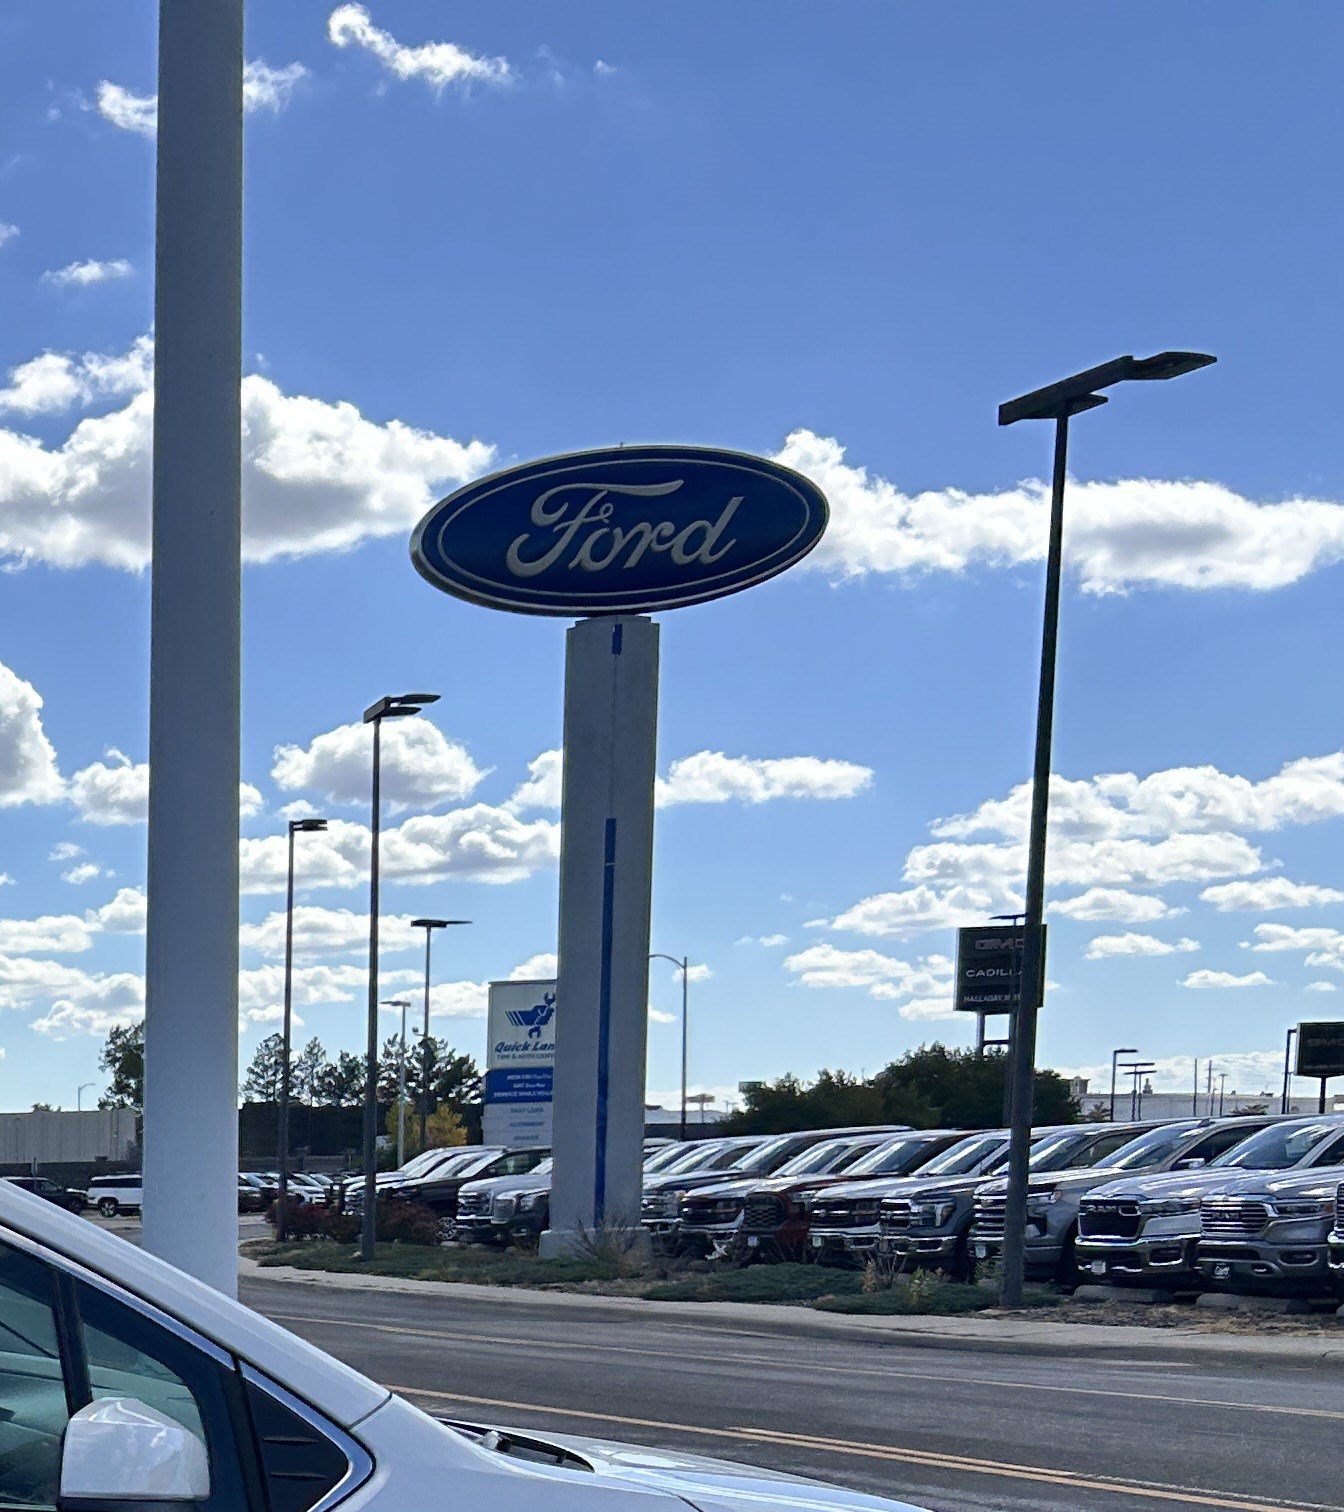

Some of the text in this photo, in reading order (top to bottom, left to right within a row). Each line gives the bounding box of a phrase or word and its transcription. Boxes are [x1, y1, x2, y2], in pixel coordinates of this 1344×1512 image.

[506, 480, 744, 577] Ford
[495, 1041, 555, 1053] Quick Lan
